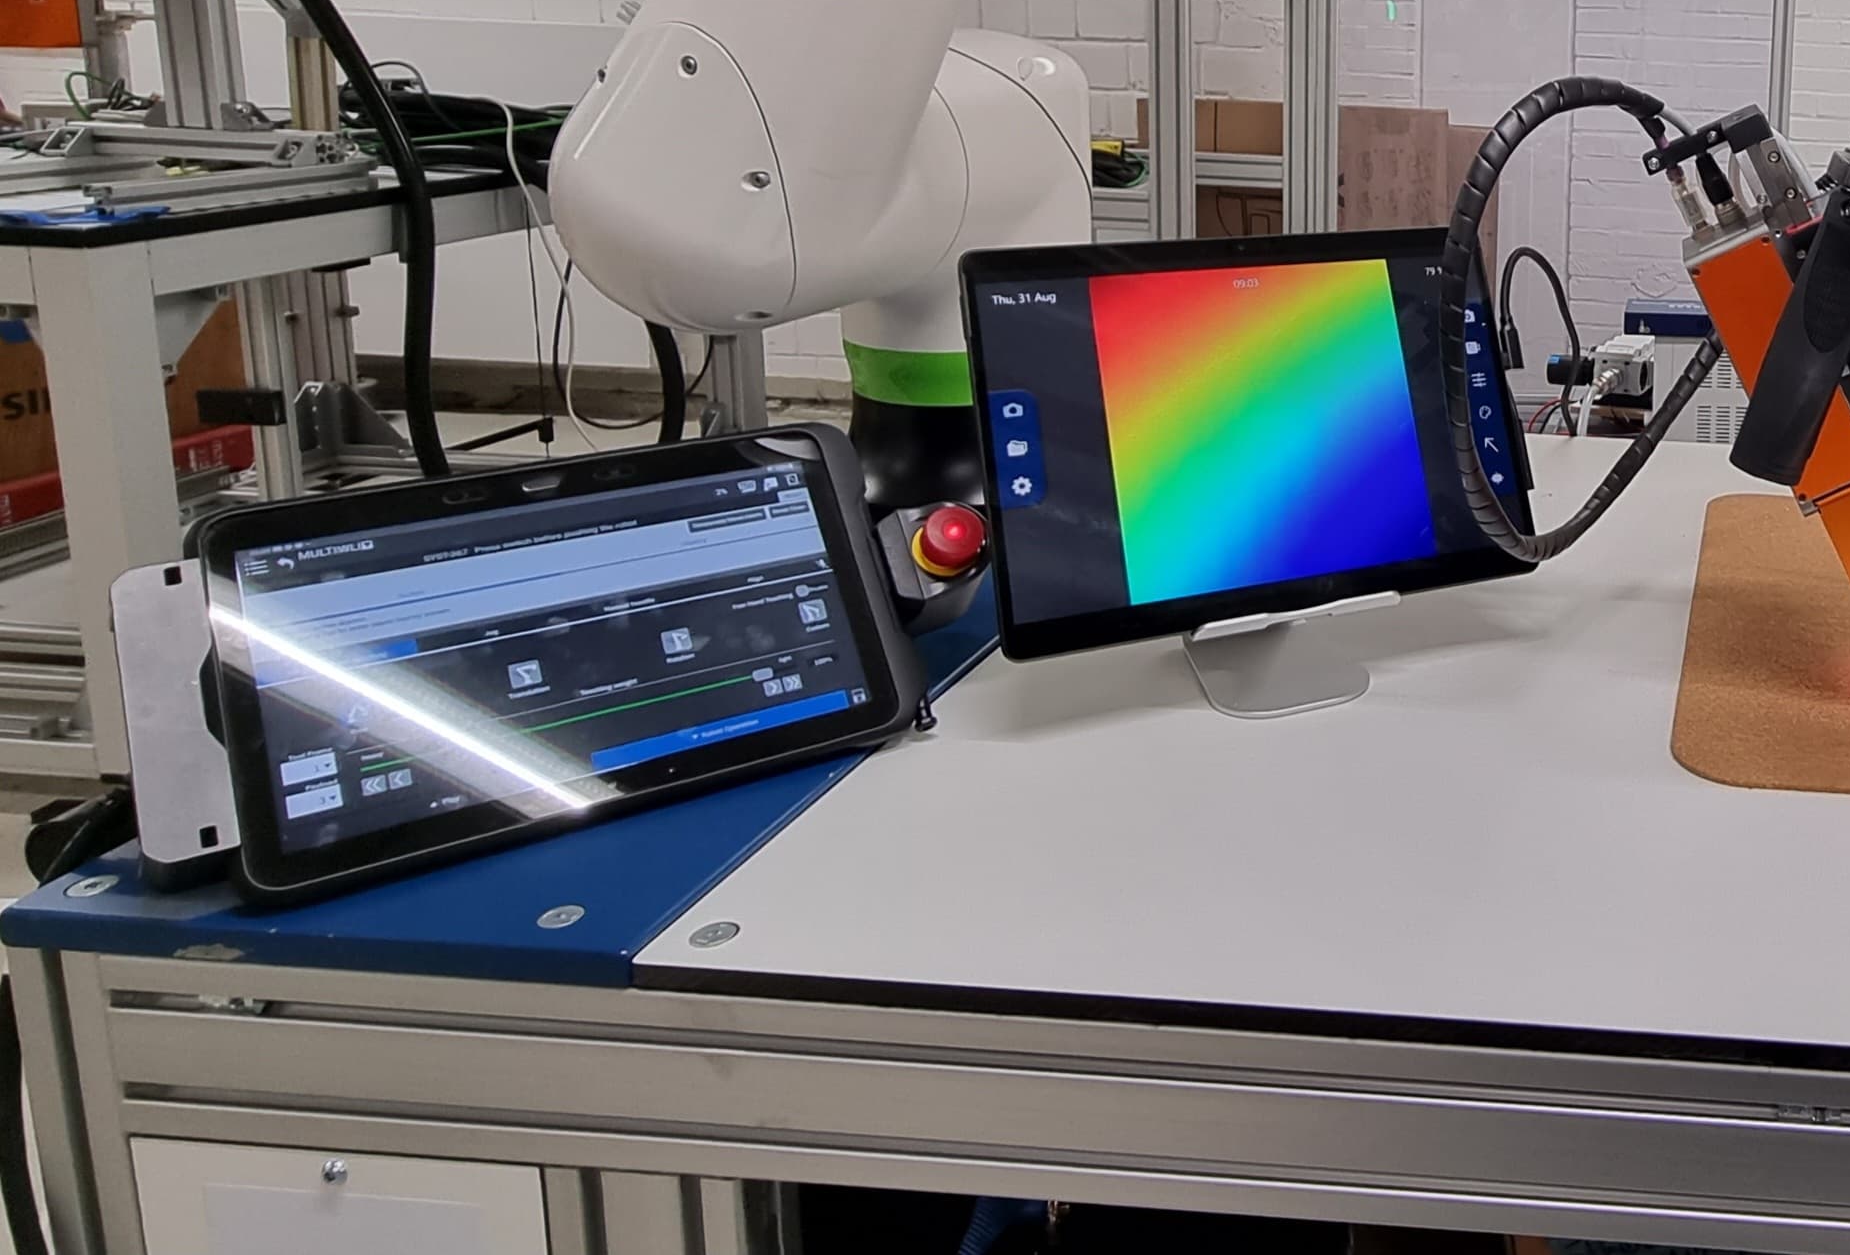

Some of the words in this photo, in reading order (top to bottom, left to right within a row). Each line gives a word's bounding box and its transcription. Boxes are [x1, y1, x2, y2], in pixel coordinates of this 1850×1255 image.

[991, 293, 1016, 306] Thu,
[1018, 292, 1031, 304] 31
[1034, 291, 1057, 305] Aug
